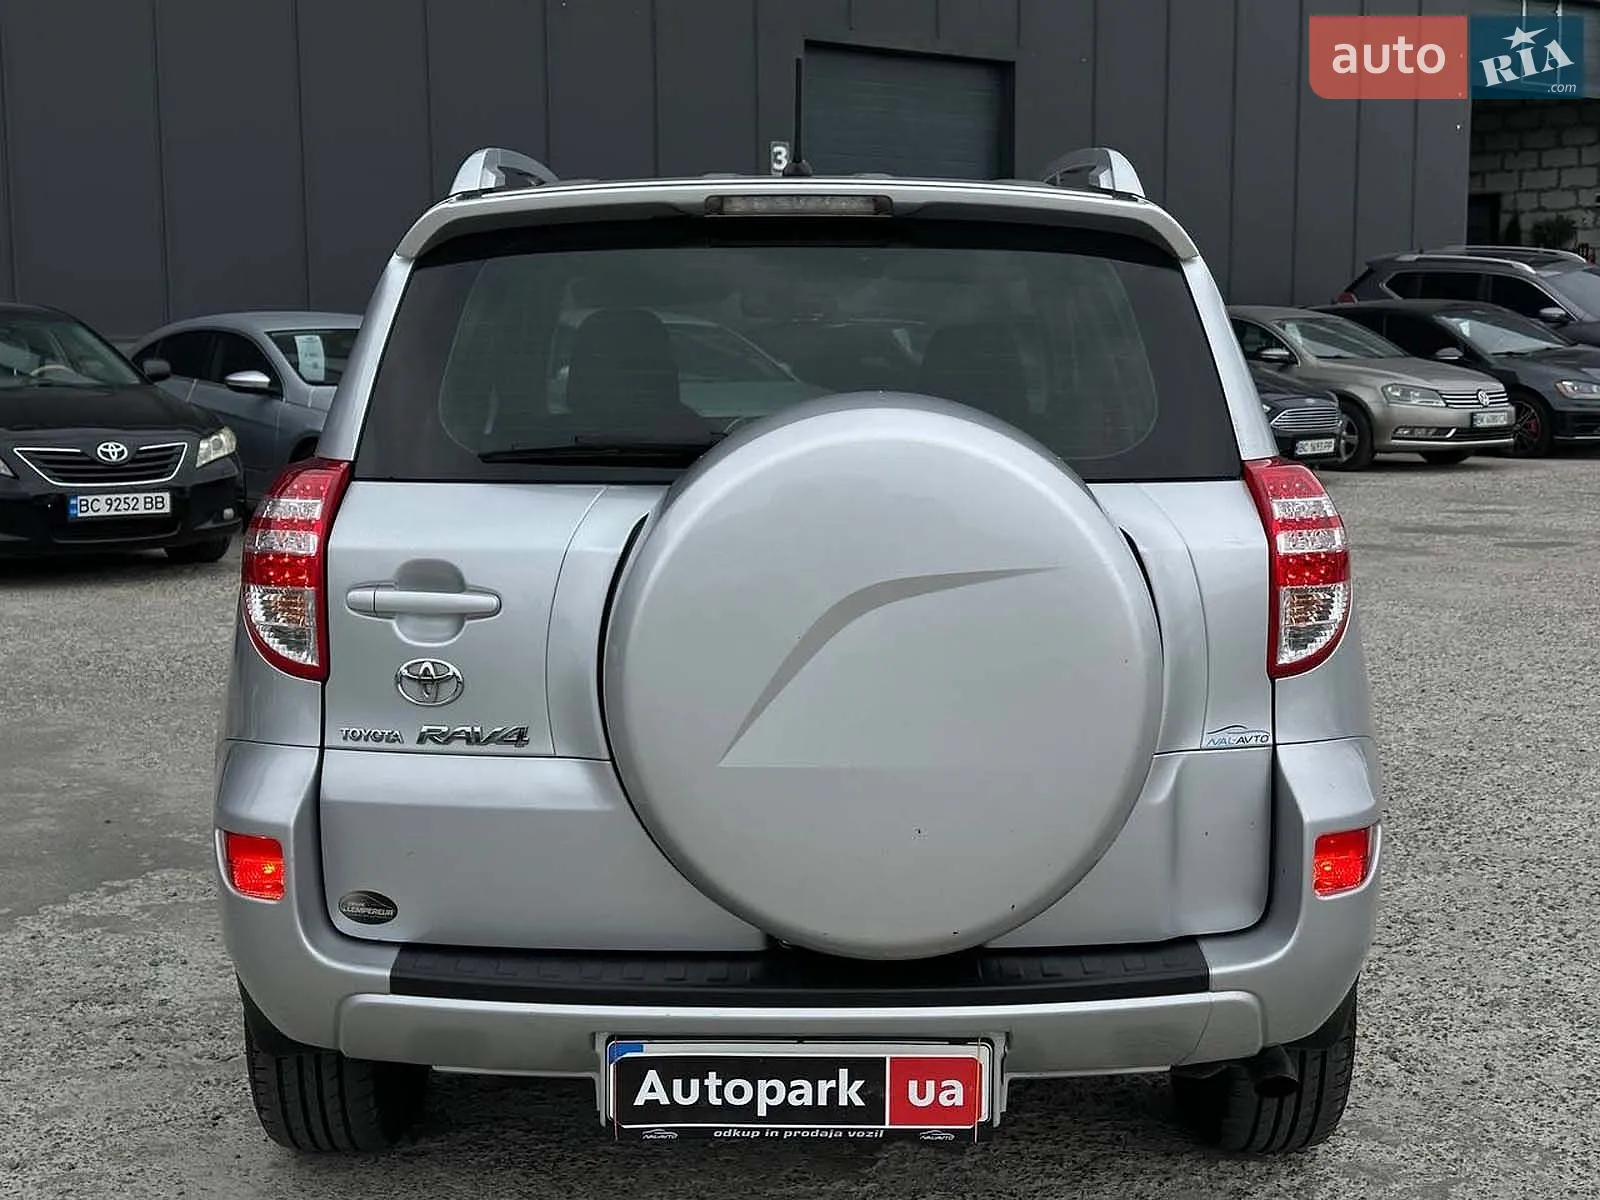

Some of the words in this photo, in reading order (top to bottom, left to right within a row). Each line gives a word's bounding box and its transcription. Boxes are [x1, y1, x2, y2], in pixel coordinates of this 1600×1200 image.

[772, 145, 787, 170] 3
[79, 498, 100, 513] BC
[104, 497, 140, 512] 9252
[143, 495, 165, 510] BB
[340, 727, 404, 744] TOYOTA
[416, 724, 530, 748] RAV4
[633, 1068, 866, 1117] Autopark
[907, 1079, 965, 1107] ua
[713, 1128, 760, 1140] odkup
[764, 1128, 779, 1138] in
[783, 1128, 843, 1140] prodaja
[848, 1128, 885, 1139] vozil
